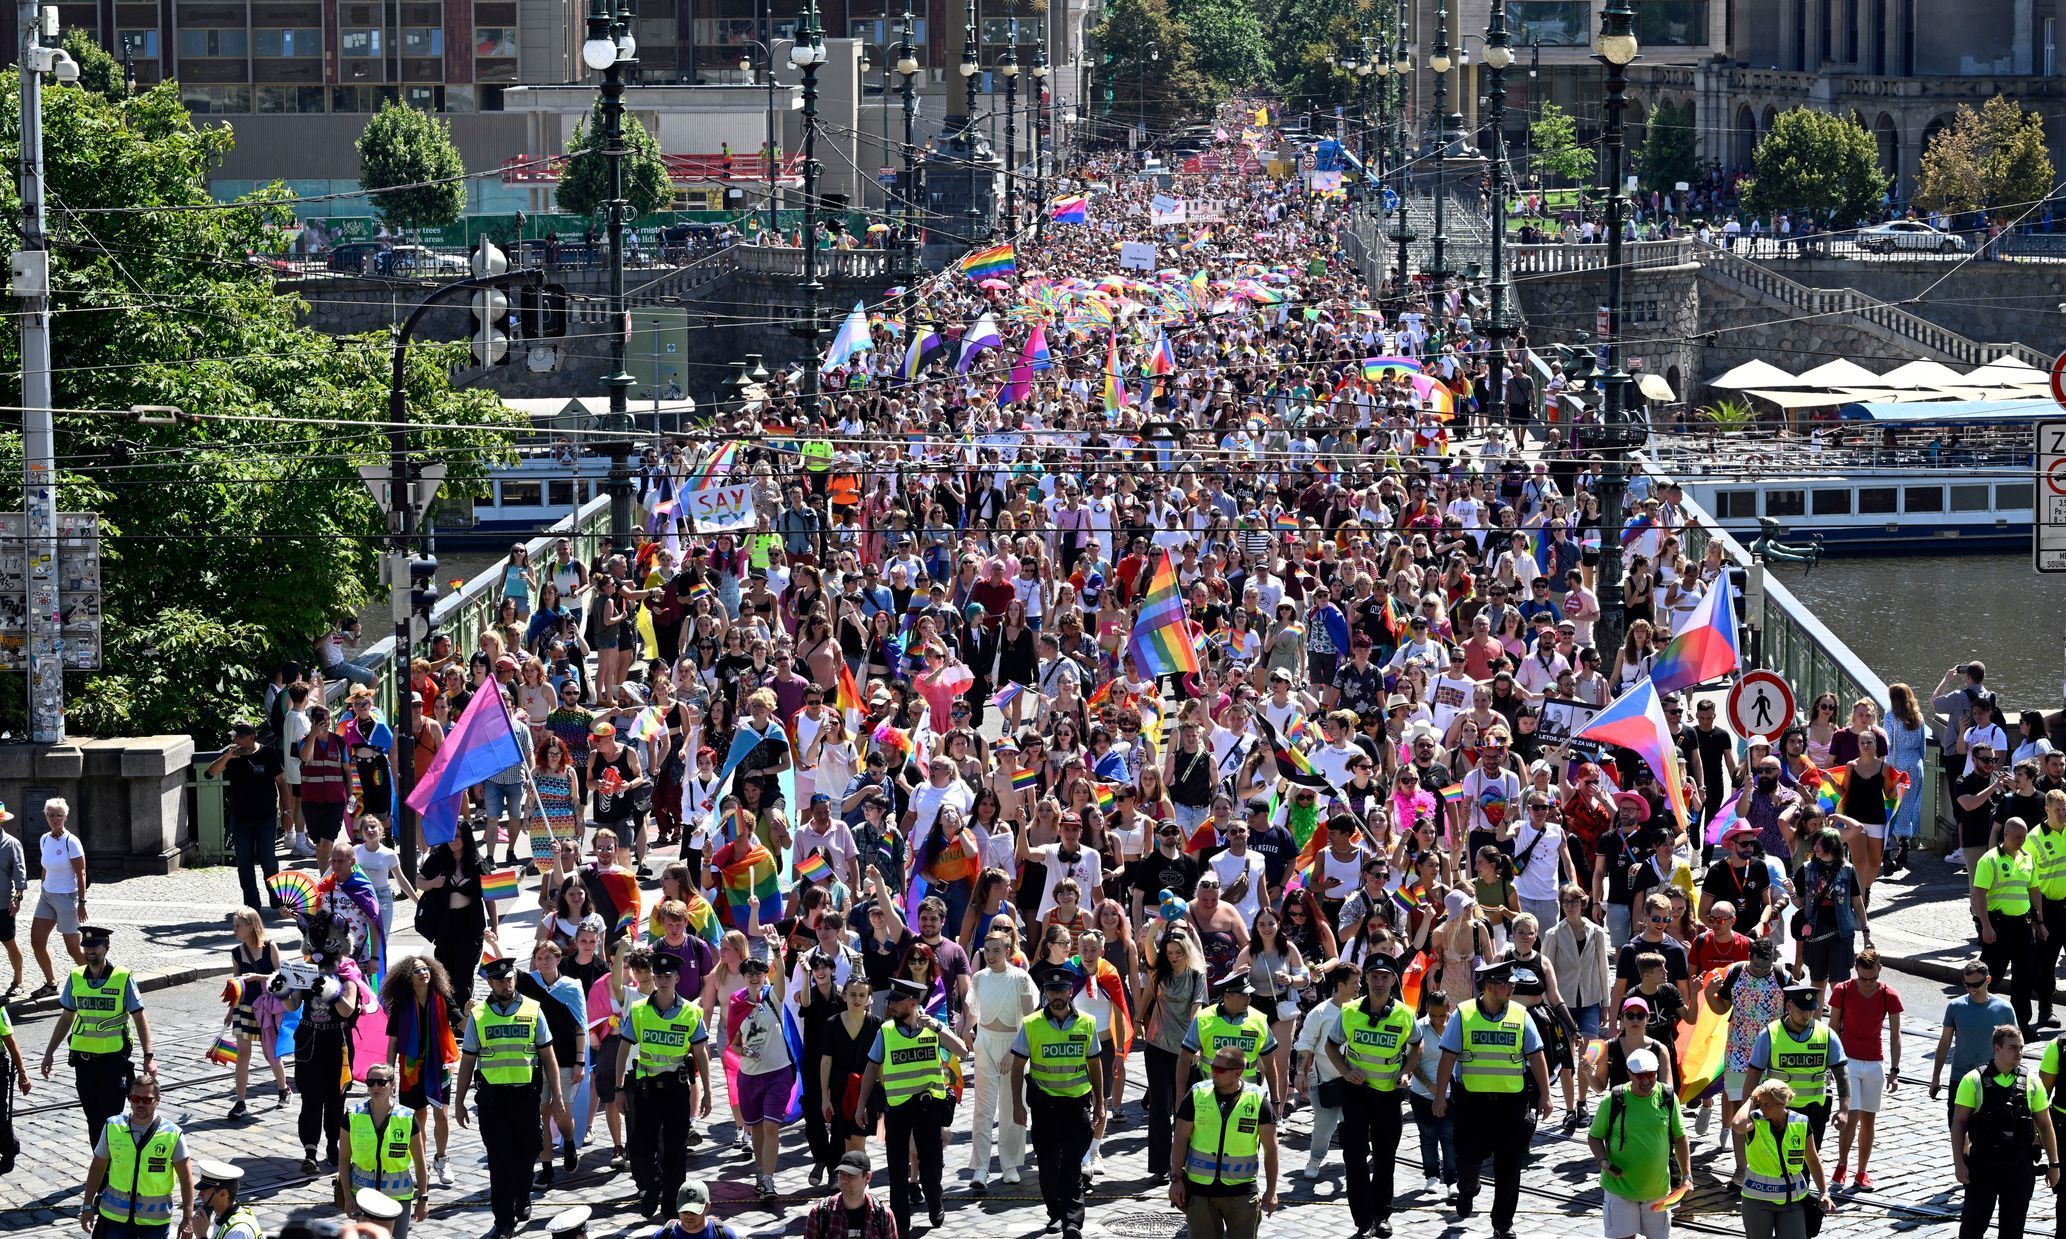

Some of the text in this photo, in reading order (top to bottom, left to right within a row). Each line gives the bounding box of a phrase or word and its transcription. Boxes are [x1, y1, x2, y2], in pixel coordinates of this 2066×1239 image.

[406, 236, 422, 244] pak
[2051, 431, 2065, 453] Z
[699, 489, 744, 515] SAY
[1539, 734, 1557, 742] LETOS
[78, 998, 115, 1010] POLICIE
[486, 1025, 529, 1039] POLICIE
[643, 1030, 684, 1046] POLICIE
[1471, 1032, 1516, 1045] POLICIE
[1213, 1037, 1255, 1051] POLICIE
[1354, 1031, 1397, 1048] POLICIE
[892, 1048, 936, 1063] POLICIE
[1042, 1043, 1083, 1057] POLICIE
[1779, 1055, 1824, 1067] POLICIE
